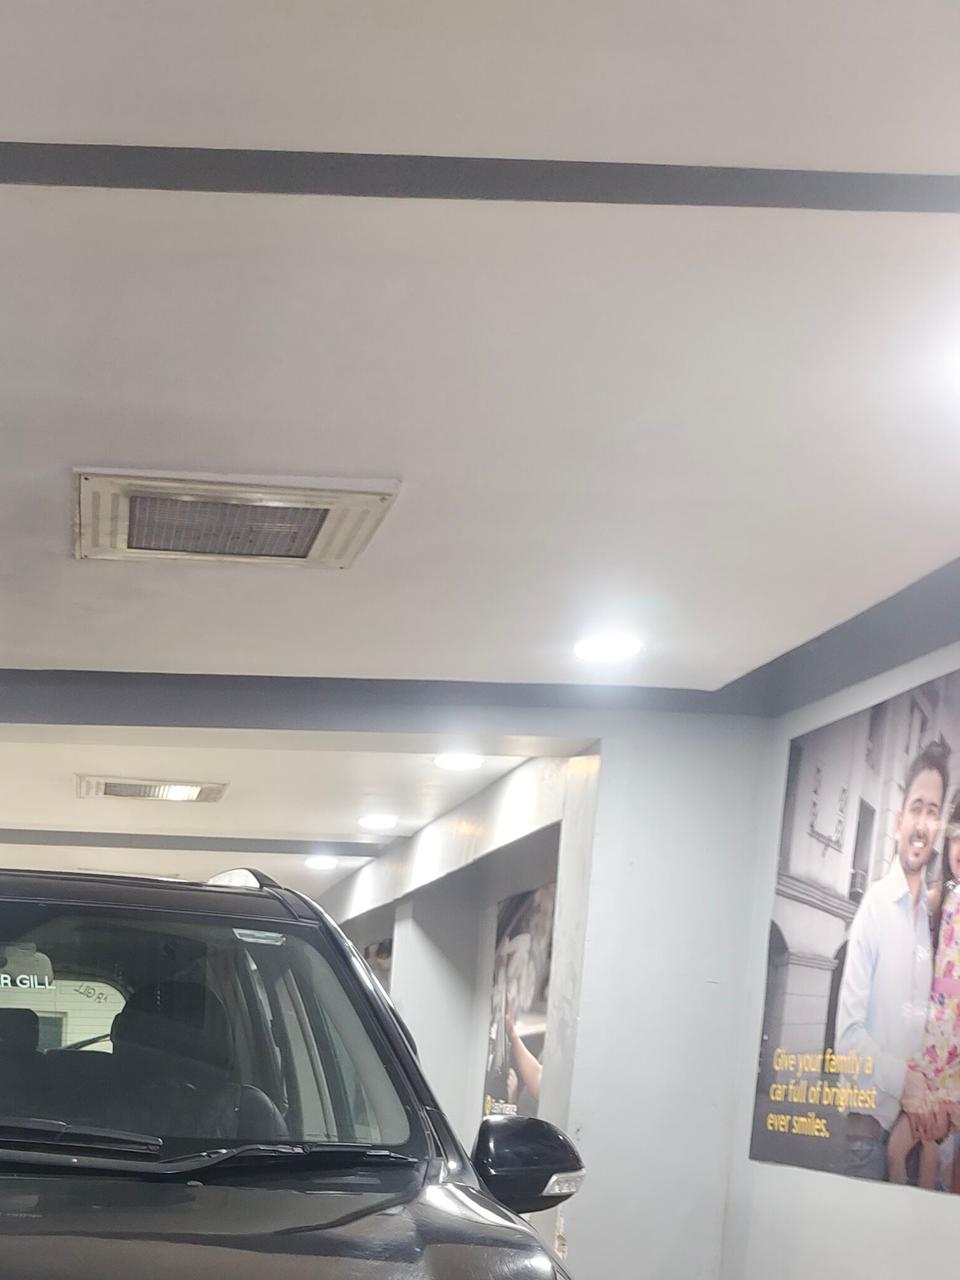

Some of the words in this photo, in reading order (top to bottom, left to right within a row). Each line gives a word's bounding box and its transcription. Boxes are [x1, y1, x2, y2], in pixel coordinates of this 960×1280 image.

[16, 974, 56, 989] GILL
[773, 1048, 796, 1071] Give
[796, 1054, 822, 1077] your
[824, 1048, 860, 1079] family
[864, 1056, 872, 1074] a
[769, 1084, 786, 1101] car
[788, 1080, 807, 1103] full
[808, 1081, 822, 1104] of
[822, 1081, 877, 1112] brightest
[767, 1113, 791, 1132] ever
